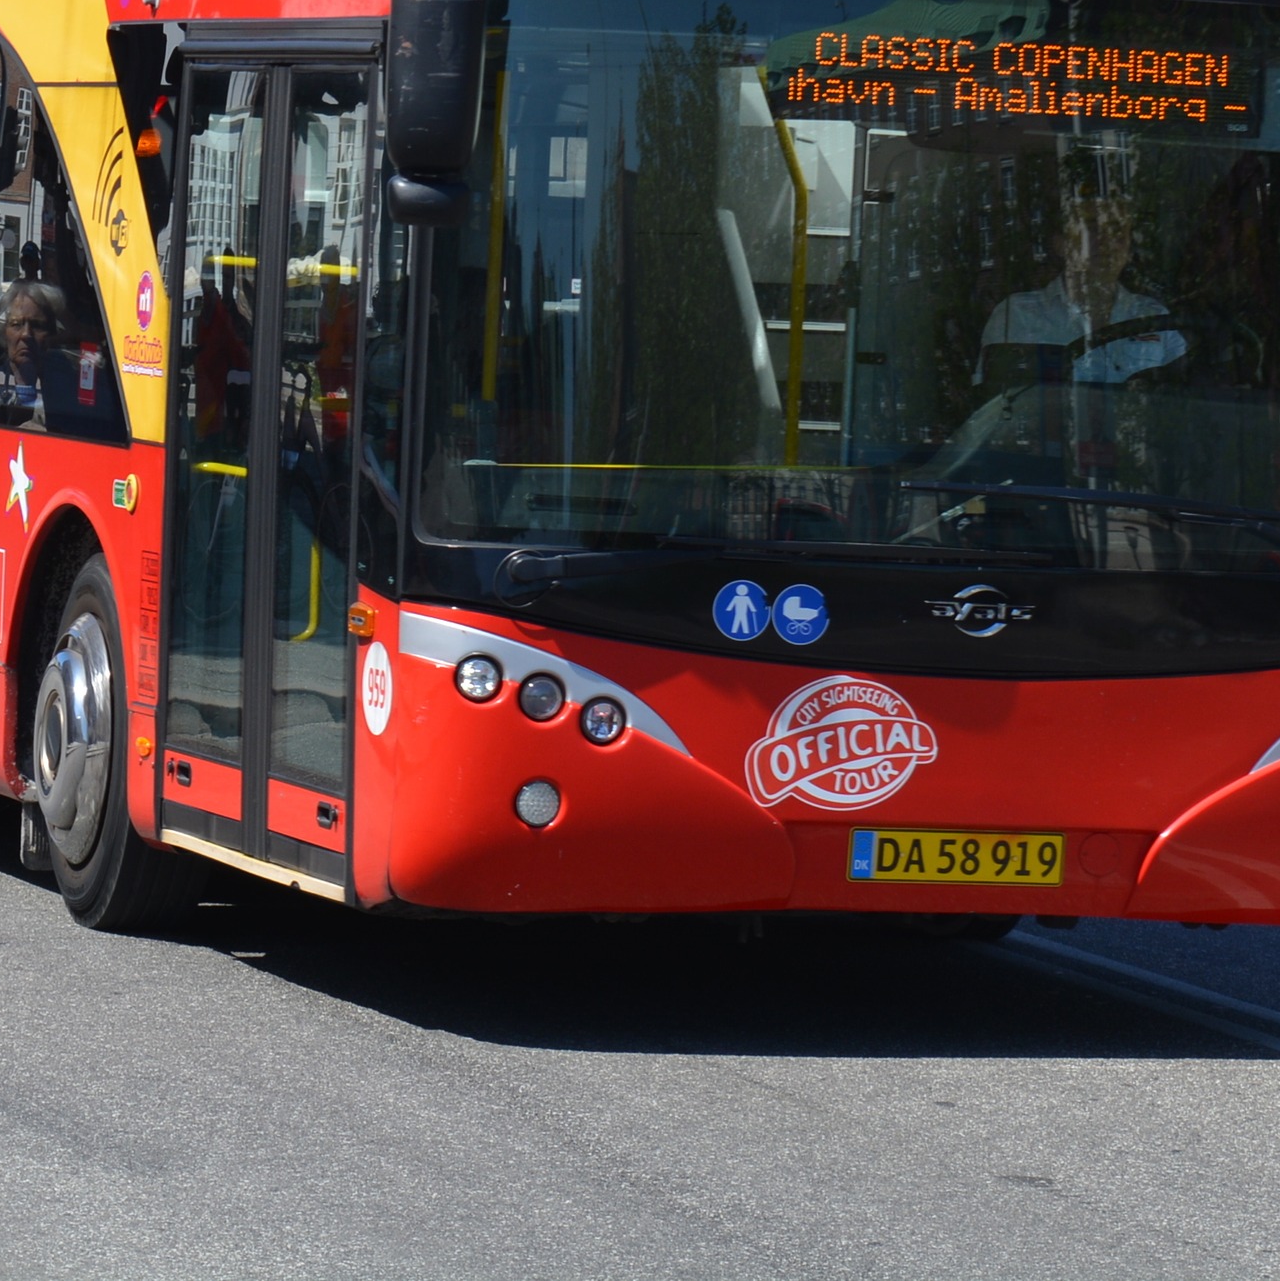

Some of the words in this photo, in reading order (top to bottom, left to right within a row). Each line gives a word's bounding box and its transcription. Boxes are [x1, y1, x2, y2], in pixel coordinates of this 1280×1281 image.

[816, 32, 975, 73] CLASSIC
[993, 42, 1230, 87] COPENHAGEN
[788, 68, 895, 107] havn
[368, 667, 386, 709] 959
[796, 698, 821, 726] CITY
[821, 685, 901, 716] SIGHTSEEING
[770, 723, 931, 782] OFFICIAL
[833, 761, 899, 794] TOUR
[853, 858, 870, 872] DK
